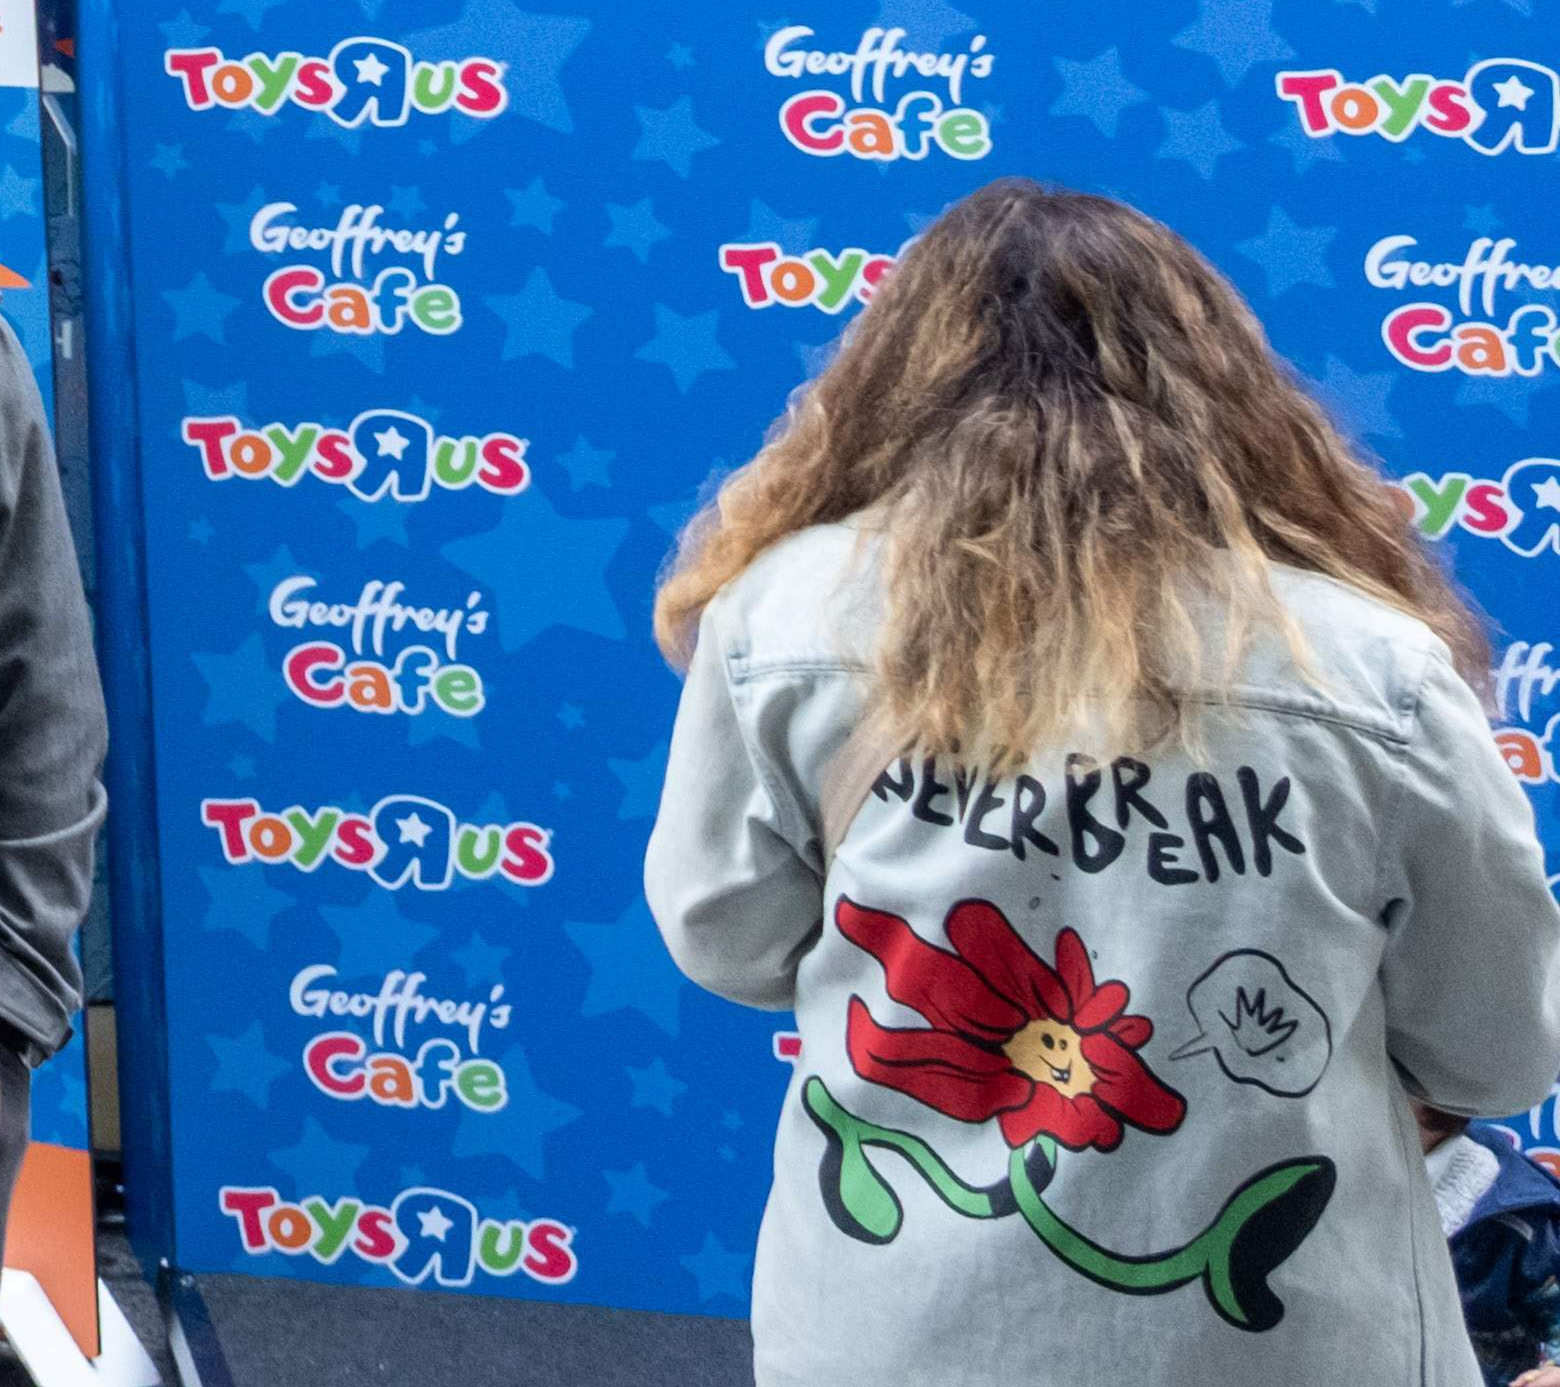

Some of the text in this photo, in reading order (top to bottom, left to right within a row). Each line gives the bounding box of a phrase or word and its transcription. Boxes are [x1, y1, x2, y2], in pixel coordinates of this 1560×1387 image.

[764, 25, 995, 104] Geoffrey's
[779, 90, 993, 161] Cafe
[249, 202, 468, 280] Geoffrey's
[263, 264, 463, 336] Cafe
[1381, 302, 1560, 378] Caf
[268, 575, 489, 661] Geoffrey's
[283, 641, 487, 718] Cafe
[288, 964, 513, 1054] Geoffrey's
[303, 1030, 511, 1114] Cafe
